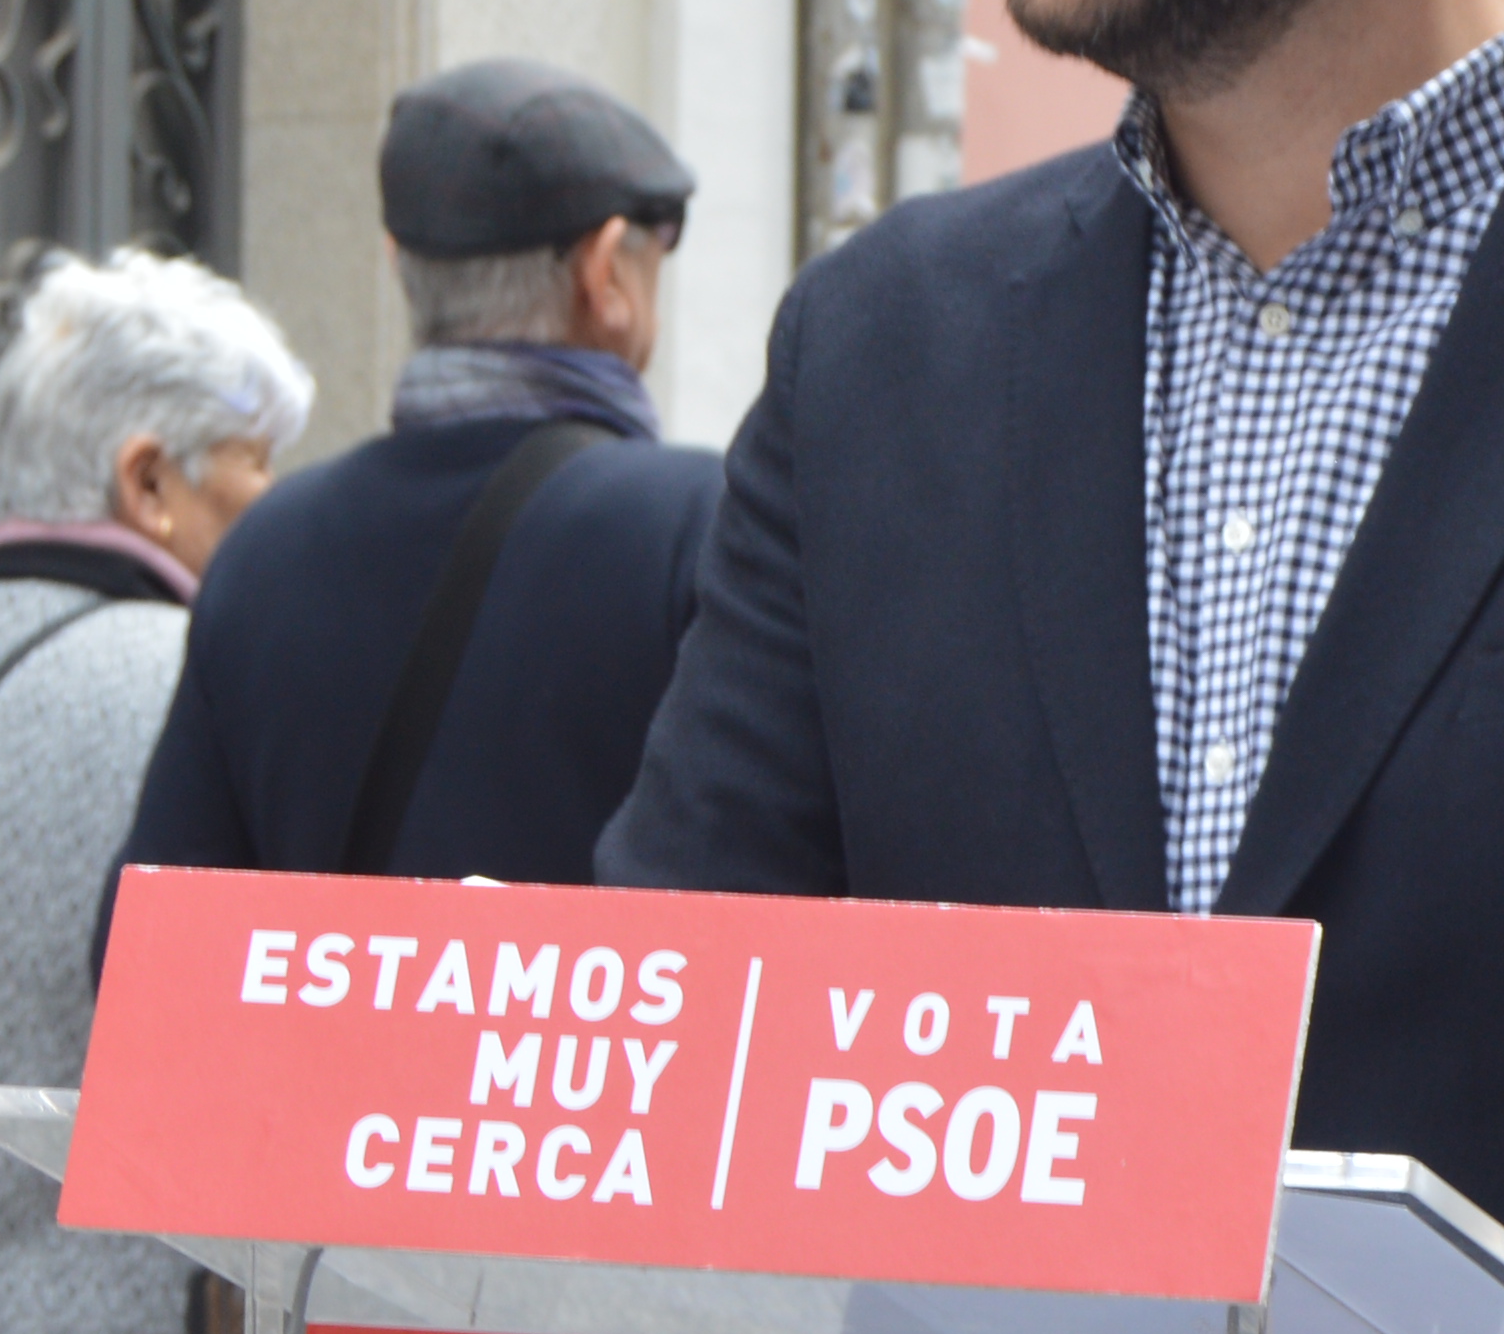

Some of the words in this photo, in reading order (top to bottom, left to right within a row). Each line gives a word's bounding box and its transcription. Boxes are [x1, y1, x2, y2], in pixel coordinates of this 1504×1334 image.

[240, 929, 688, 1026] ESTAMOS
[469, 1031, 679, 1115] MUY
[828, 987, 1103, 1065] VOTA
[344, 1113, 655, 1207] CERCA
[796, 1078, 1098, 1207] PSOE
